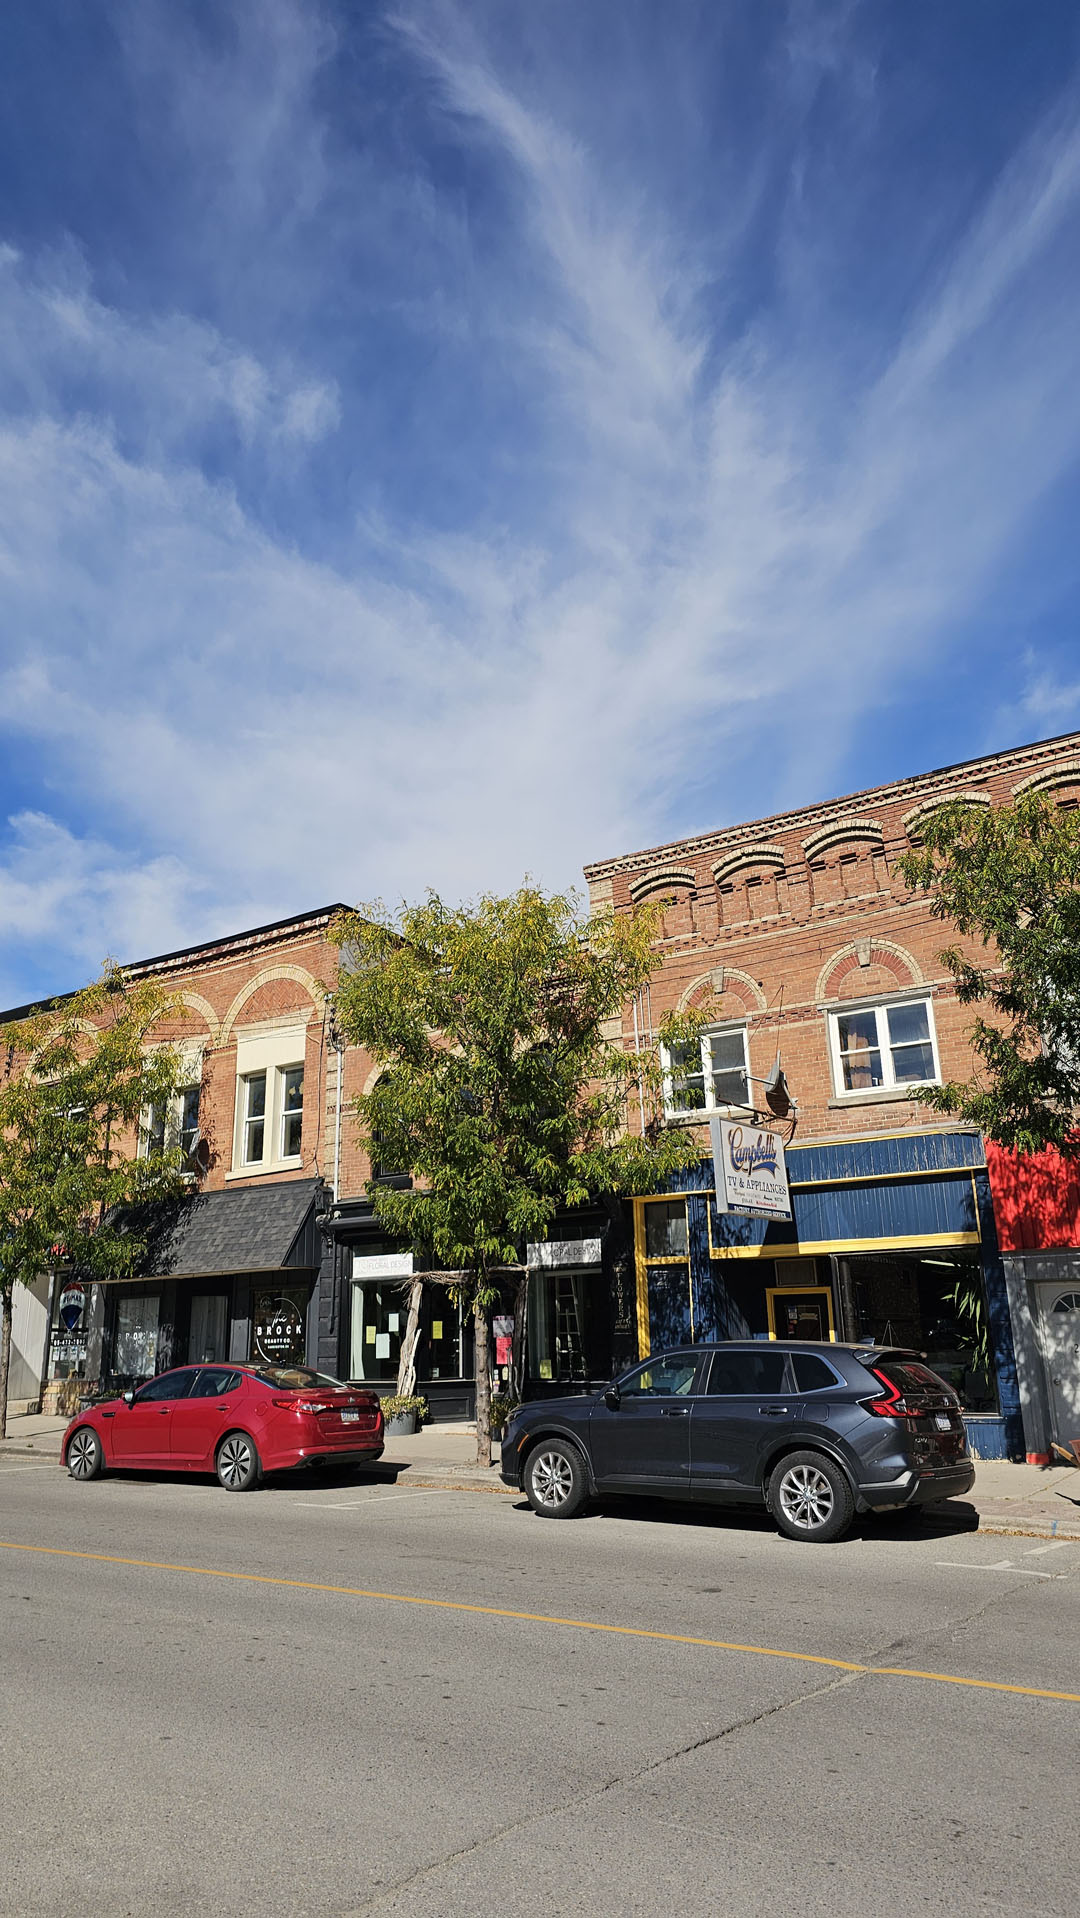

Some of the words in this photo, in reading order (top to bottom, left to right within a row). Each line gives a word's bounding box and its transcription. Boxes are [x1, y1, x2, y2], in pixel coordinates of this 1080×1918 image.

[727, 1176, 737, 1186] TV
[739, 1178, 744, 1188] &
[746, 1179, 787, 1195] APPLIANCES
[257, 1325, 302, 1336] BROCK
